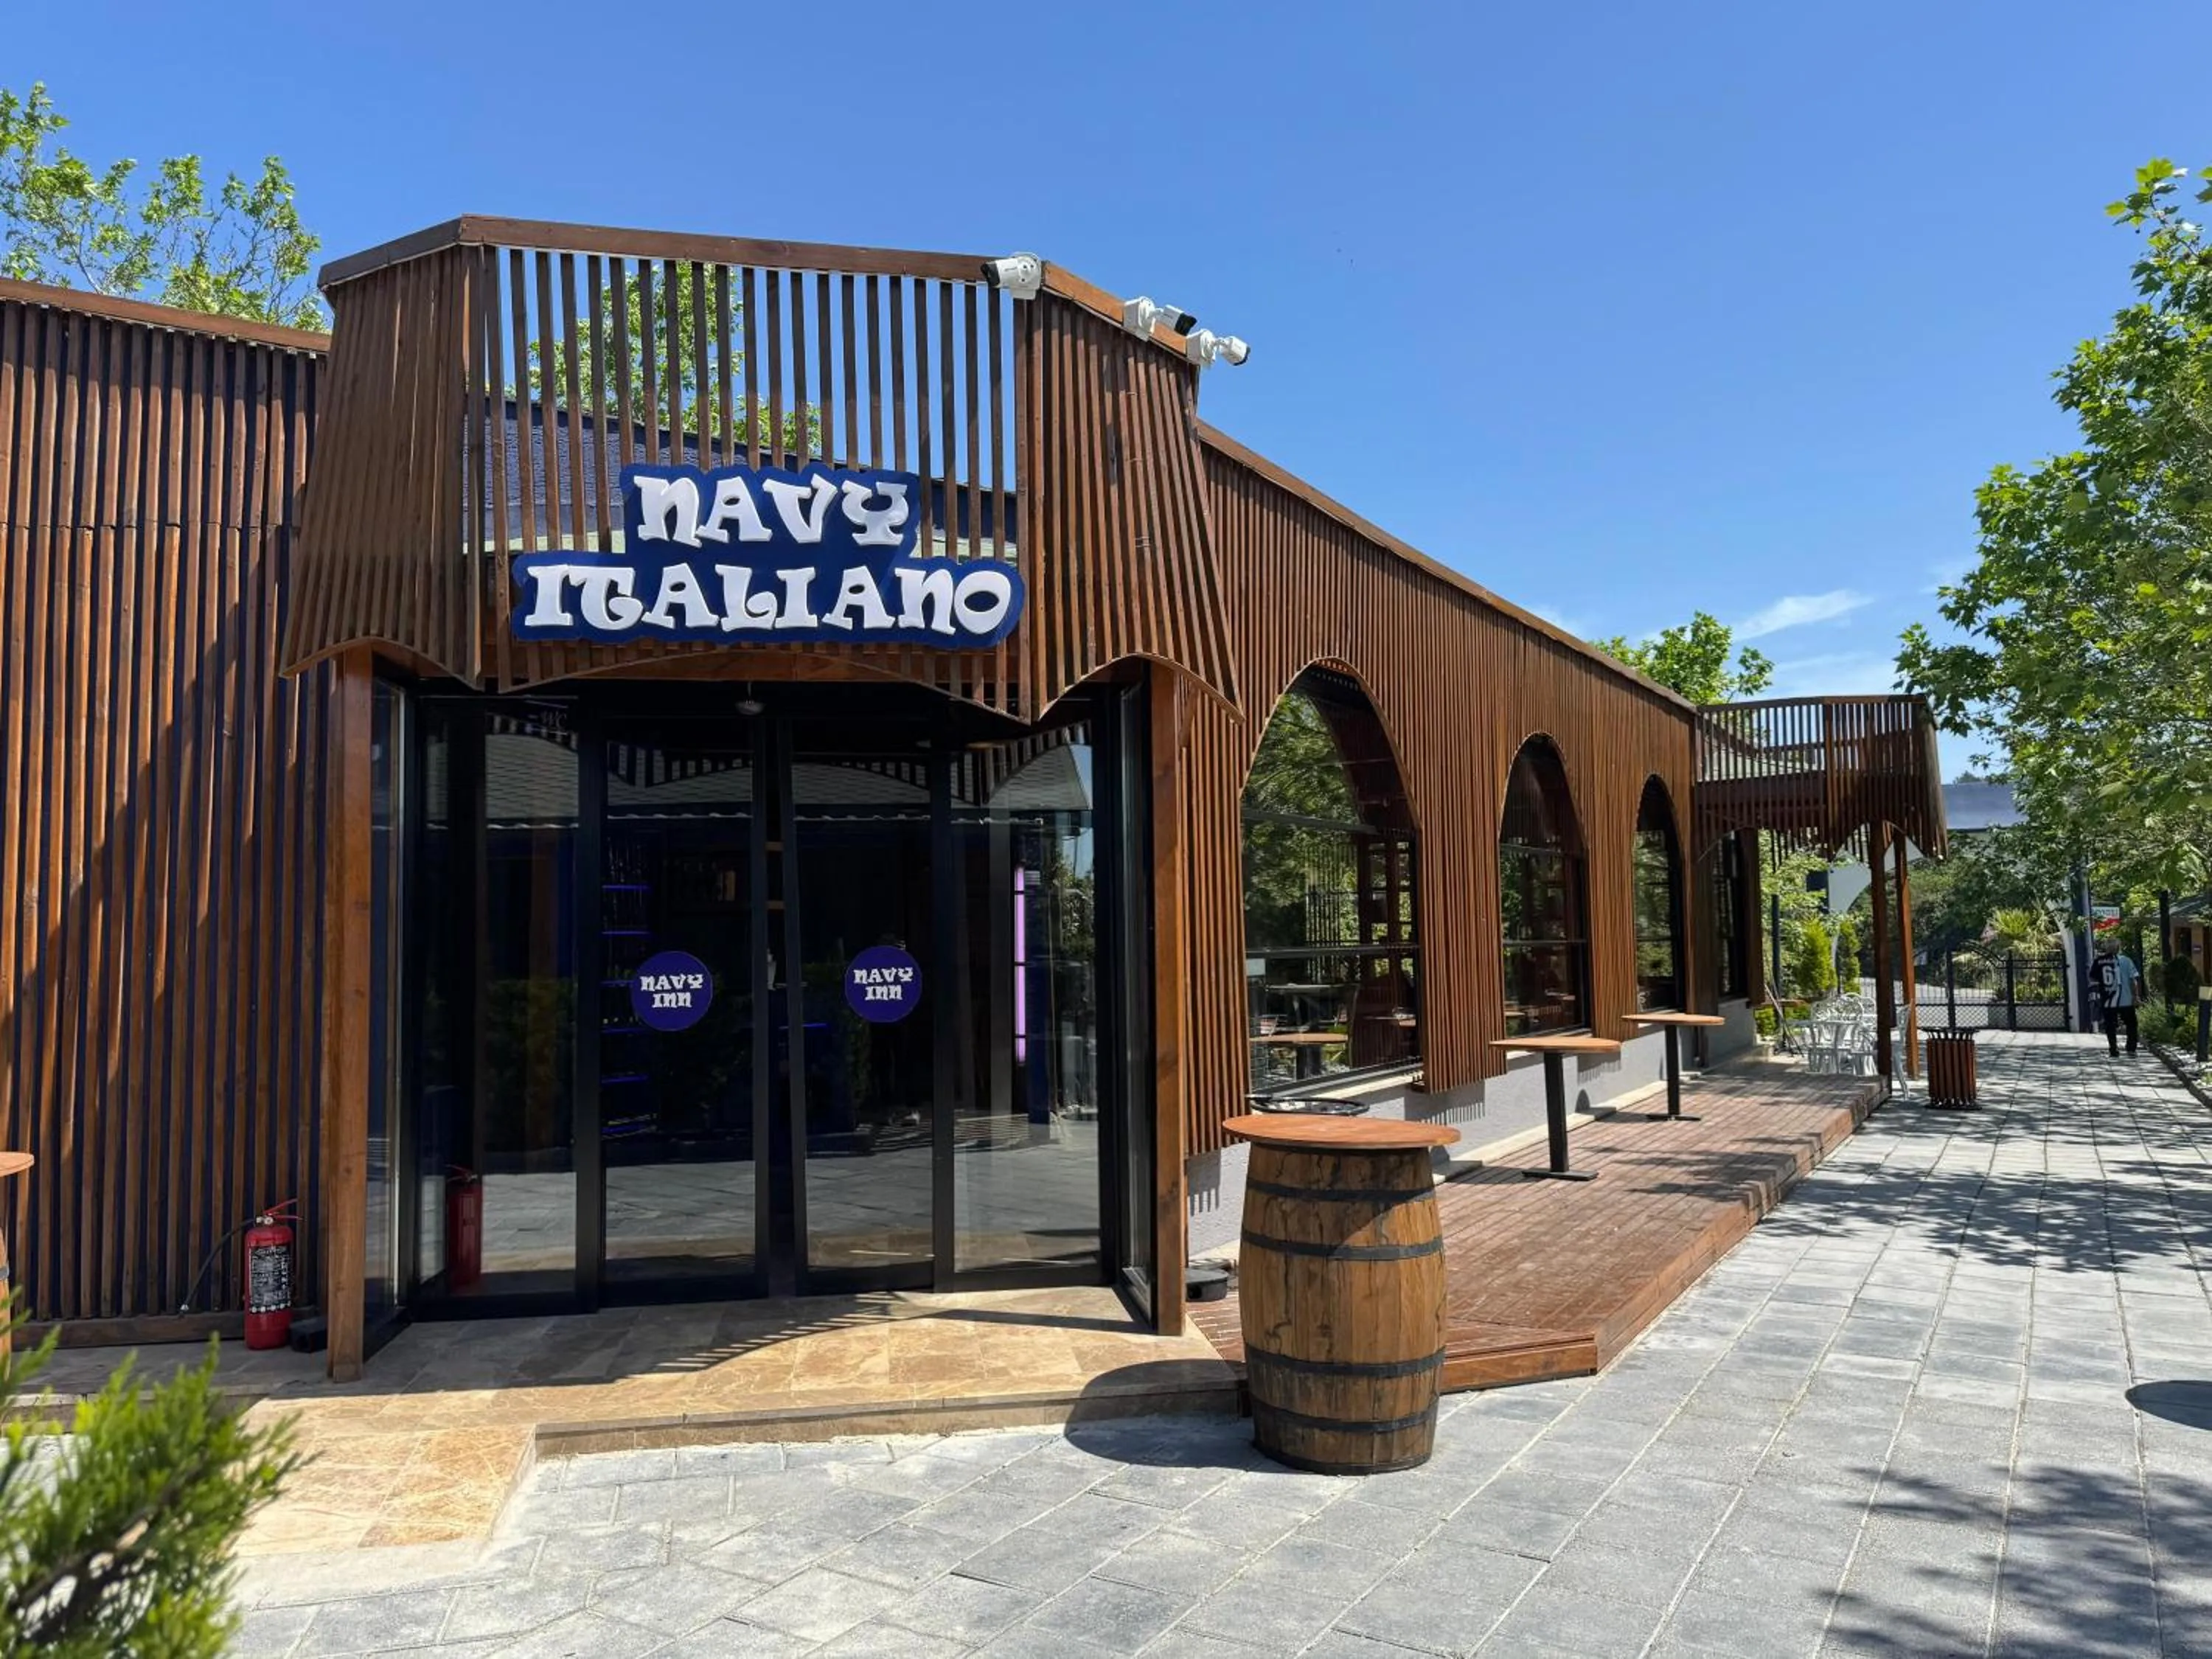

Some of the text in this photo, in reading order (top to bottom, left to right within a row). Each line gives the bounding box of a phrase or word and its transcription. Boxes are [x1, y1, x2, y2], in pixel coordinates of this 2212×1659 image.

[633, 473, 909, 547] NAVY
[525, 563, 1012, 635] ITALIANO
[640, 973, 704, 992] NAVY
[853, 967, 914, 984] NAVY
[652, 992, 692, 1009] INN
[864, 984, 903, 1001] INN
